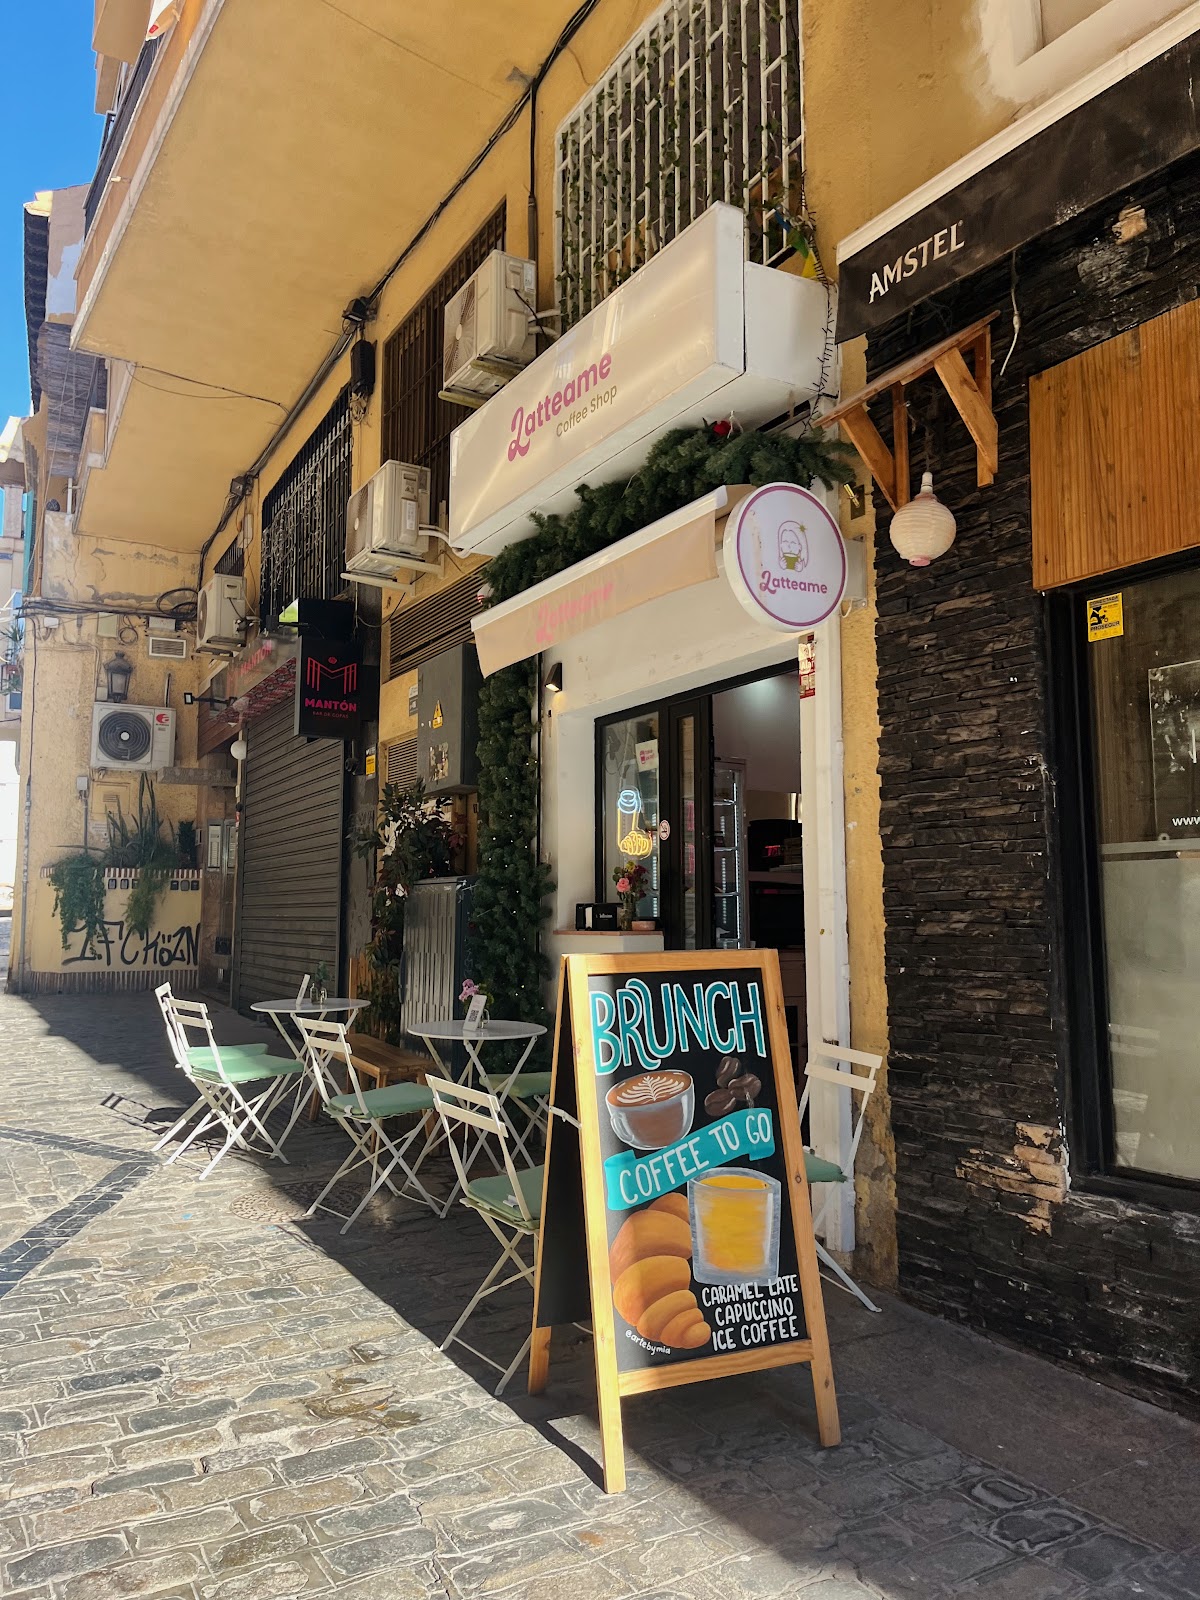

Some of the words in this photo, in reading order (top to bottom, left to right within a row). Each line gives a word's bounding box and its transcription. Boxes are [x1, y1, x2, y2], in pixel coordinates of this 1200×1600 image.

[869, 223, 965, 304] AMSTEL
[508, 353, 612, 462] Latteame
[556, 407, 588, 437] Coffee
[590, 385, 618, 413] Shop
[759, 570, 828, 595] Latteame
[304, 697, 357, 712] MANTÓN
[588, 977, 767, 1076] BRUNCH
[619, 1136, 710, 1205] COFFEE
[708, 1121, 740, 1156] TO
[745, 1112, 771, 1145] GO
[701, 1281, 764, 1307] CARAMEL
[767, 1274, 799, 1297] LATE
[714, 1297, 794, 1327] CAPUCCINO
[712, 1327, 737, 1352] ICE
[740, 1315, 799, 1346] COFFEE
